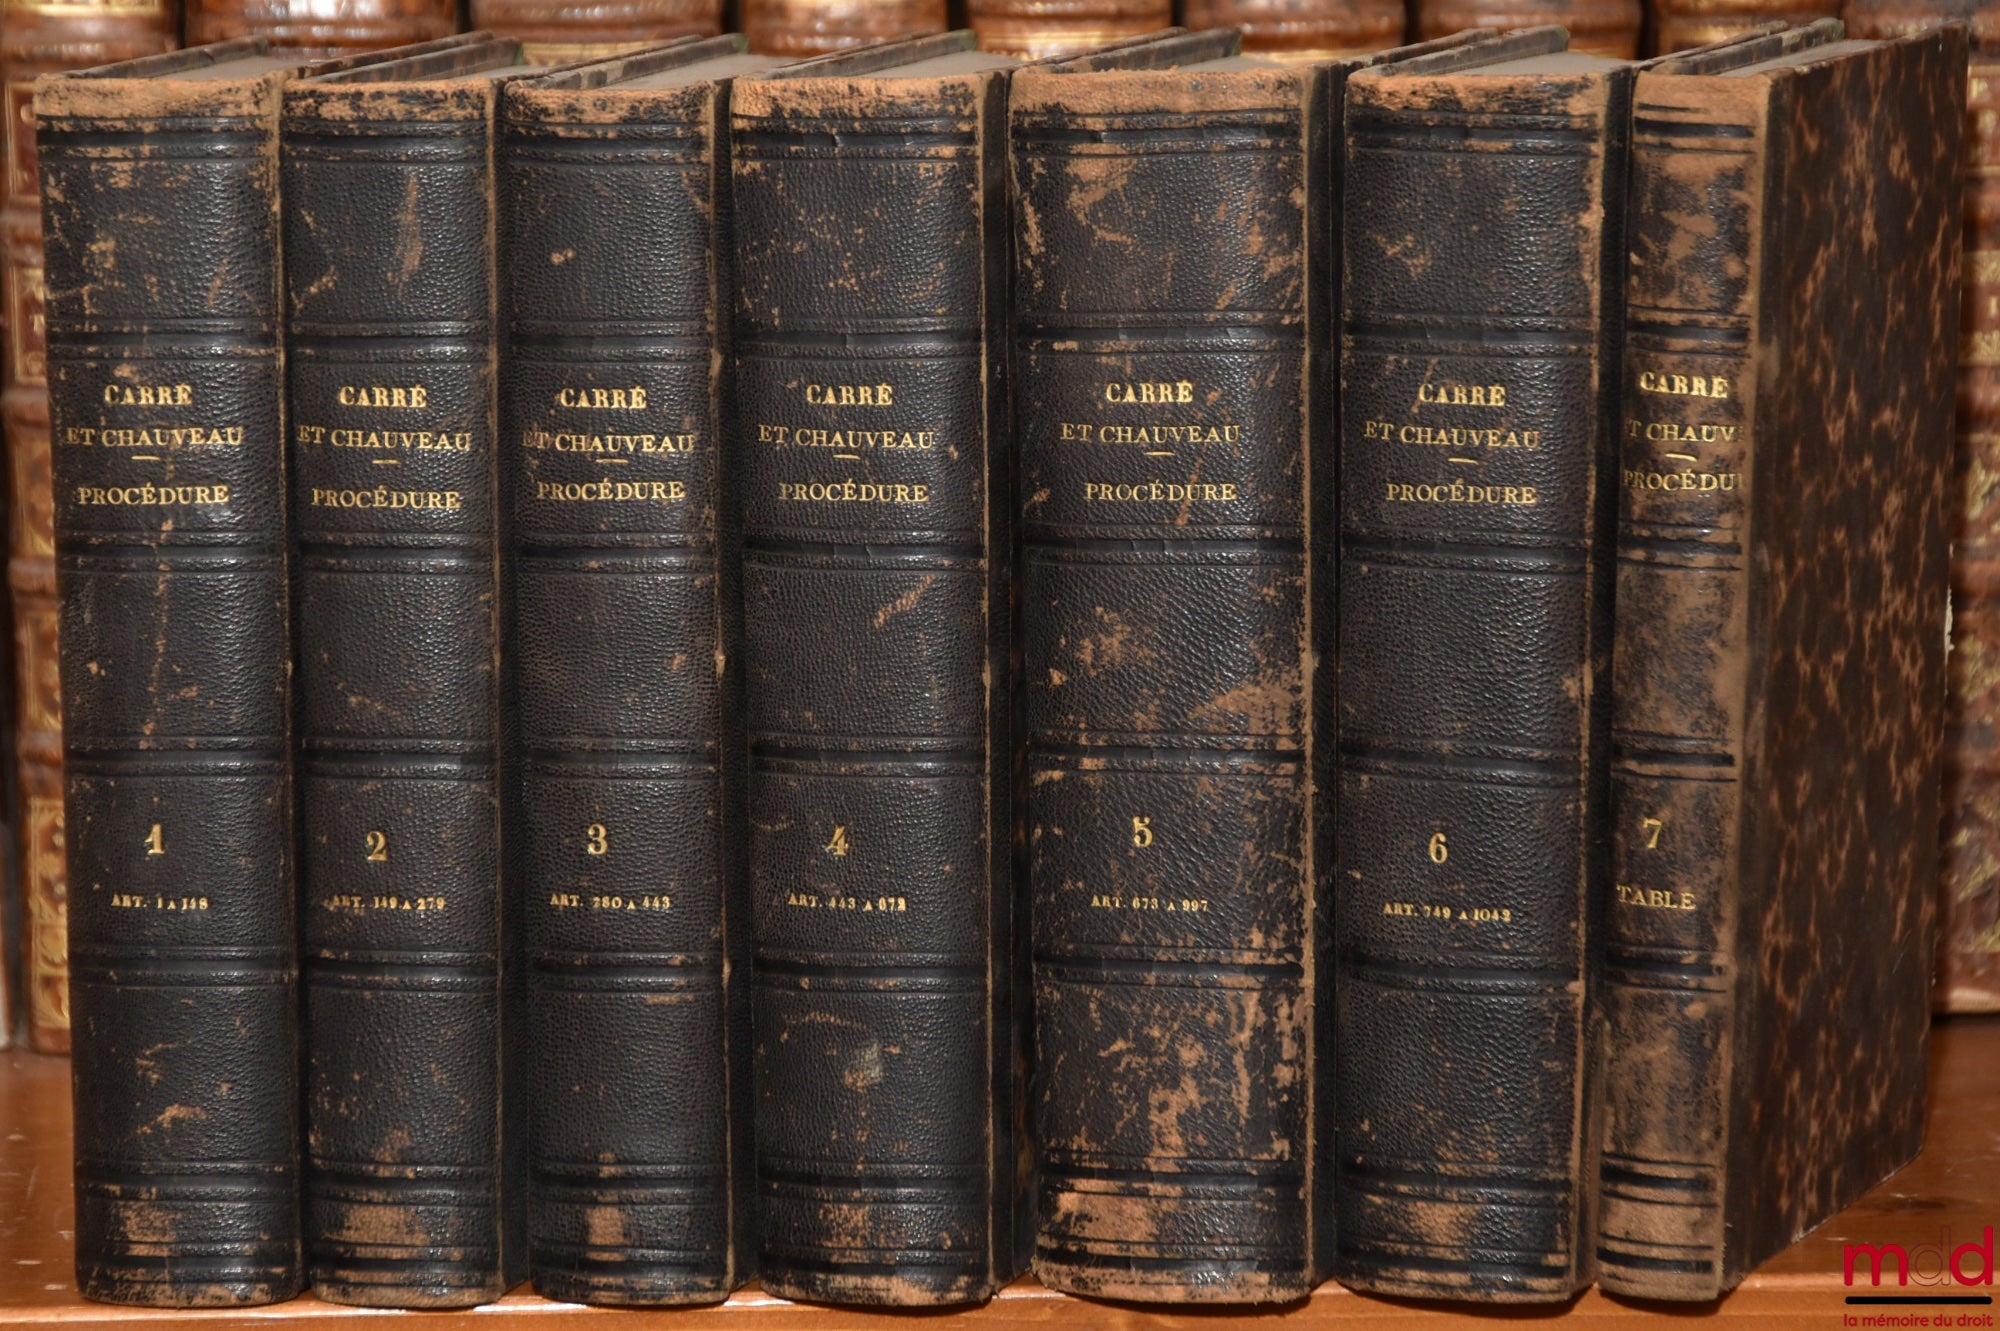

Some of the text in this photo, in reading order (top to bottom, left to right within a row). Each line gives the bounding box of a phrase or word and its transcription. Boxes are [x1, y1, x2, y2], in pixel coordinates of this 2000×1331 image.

[104, 383, 193, 406] CARRÉ
[339, 384, 427, 408] CARRÉ
[806, 383, 893, 406] CARRÉ
[1106, 380, 1194, 403] CARRÉ
[1418, 383, 1506, 407] CARRÉ
[1640, 371, 1729, 398] CARRÉ
[560, 385, 647, 409] CARRÉ
[66, 426, 245, 447] ET CHAUVEAU
[297, 425, 472, 451] ET CHAUVEAU
[522, 431, 696, 453] ET CHAUVEAU
[758, 424, 935, 449] ET CHAUVEAU
[1060, 423, 1240, 444] ET CHAUVEAU
[1363, 421, 1540, 449] ET CHAUVEAU
[78, 482, 230, 506] PROCÉDURE
[312, 484, 462, 509] PROCÉDURE
[537, 477, 686, 501] PROCÉDURE
[778, 478, 930, 502] PROCÉDURE
[1084, 478, 1237, 501] PROCÉDURE
[1386, 478, 1537, 504] PROCÉDURE
[144, 823, 165, 854] 1
[587, 824, 608, 855] 3
[825, 825, 850, 856] 4
[1133, 816, 1153, 848] 5
[1642, 818, 1662, 849] 7
[366, 831, 388, 861] 2
[1429, 832, 1448, 864] 6
[111, 894, 148, 908] ART.
[332, 895, 366, 908] ART.
[402, 900, 412, 910] A
[417, 897, 446, 910] 279
[550, 894, 584, 907] ART.
[626, 900, 637, 910] A
[642, 896, 671, 910] 443
[788, 893, 823, 908] ART.
[863, 900, 873, 911] A
[1091, 895, 1127, 908] ART.
[1167, 901, 1176, 911] A
[1182, 900, 1209, 912] 997
[1616, 884, 1697, 910] TABLE
[1383, 903, 1419, 917] ART.
[1459, 910, 1468, 920] A
